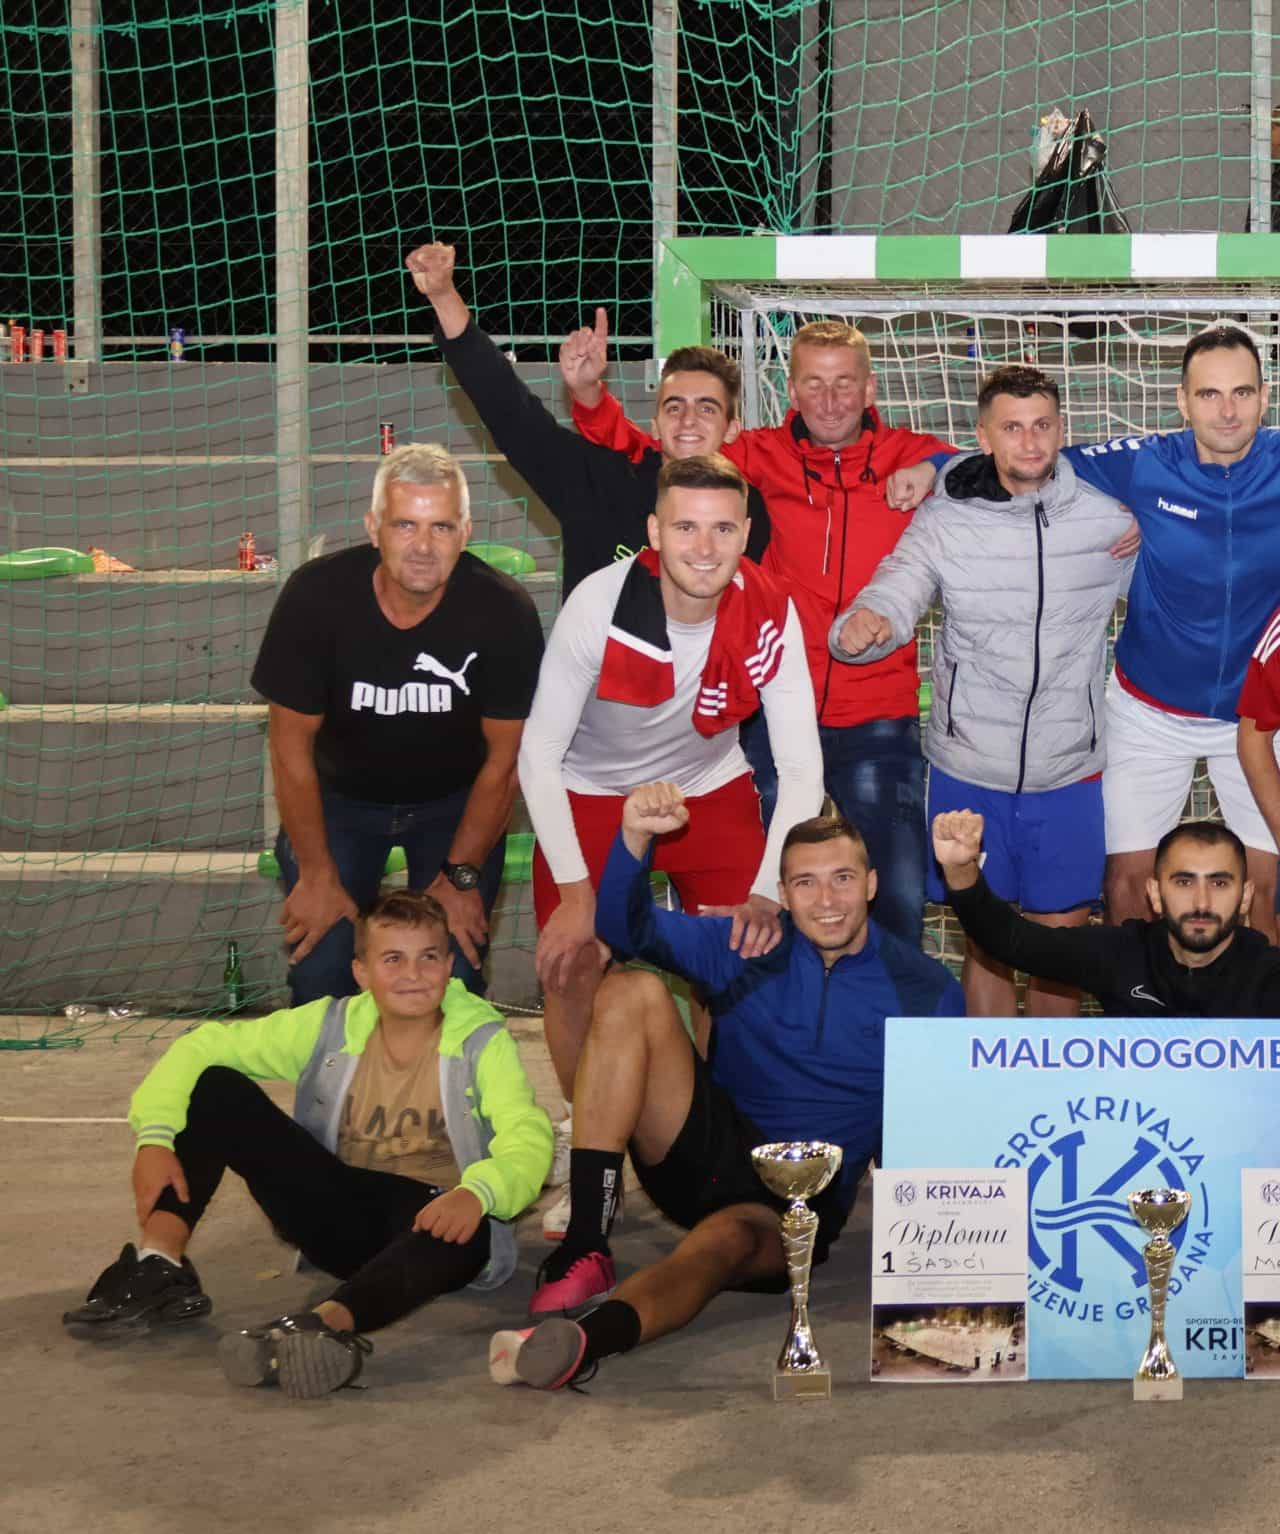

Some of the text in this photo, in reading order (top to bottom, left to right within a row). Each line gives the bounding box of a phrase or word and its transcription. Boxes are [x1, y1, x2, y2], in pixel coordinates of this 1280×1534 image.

[351, 681, 452, 715] PUMA
[994, 1095, 1205, 1177] SRC KRIVAJA
[926, 1185, 1006, 1200] KRIVAJA
[889, 1219, 1008, 1251] Diplomu
[881, 1251, 895, 1273] 1
[1116, 1232, 1214, 1320] GRĐANA
[1186, 1327, 1244, 1351] KRI
